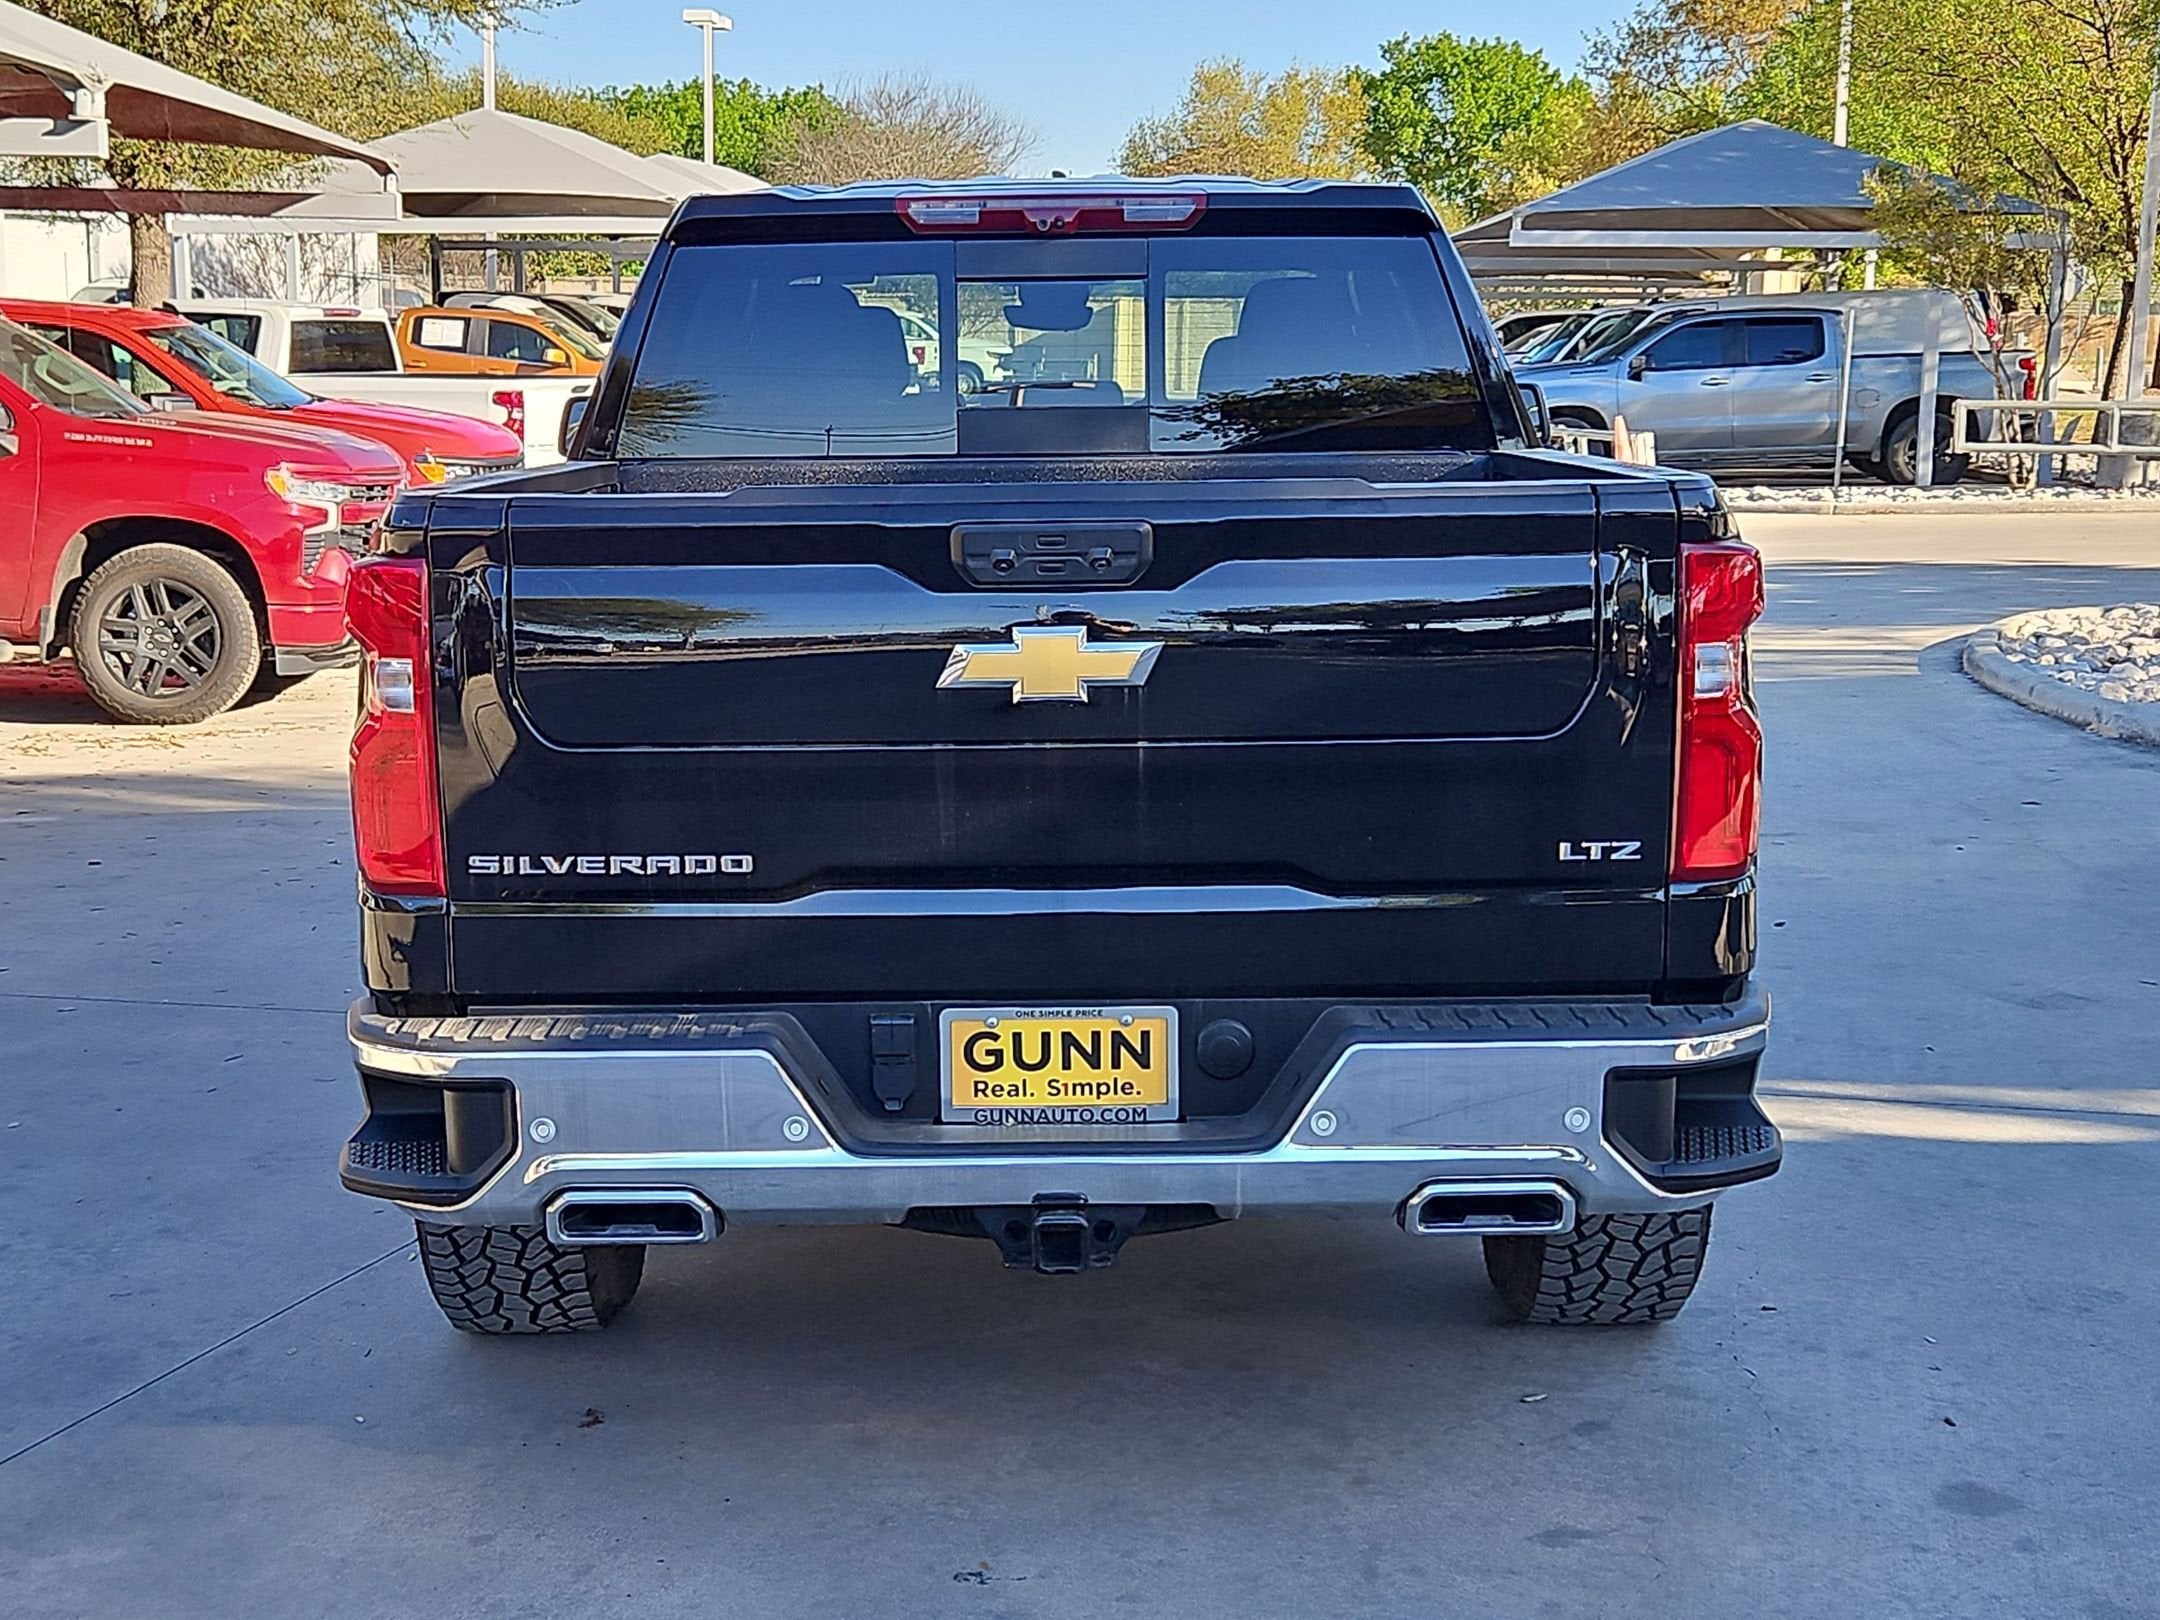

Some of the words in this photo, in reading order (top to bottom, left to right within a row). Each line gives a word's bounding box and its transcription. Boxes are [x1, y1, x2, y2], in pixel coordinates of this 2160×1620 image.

[1559, 841, 1642, 860] LTZ
[468, 855, 754, 875] SILVERADO
[1015, 1010, 1037, 1018] ONE
[1038, 1009, 1073, 1018] SIMPLE
[1075, 1009, 1104, 1018] PRICE
[963, 1030, 1152, 1072] GUNN
[973, 1078, 1035, 1098] Real.
[973, 1107, 1148, 1124] GUNNAUTO.COM
